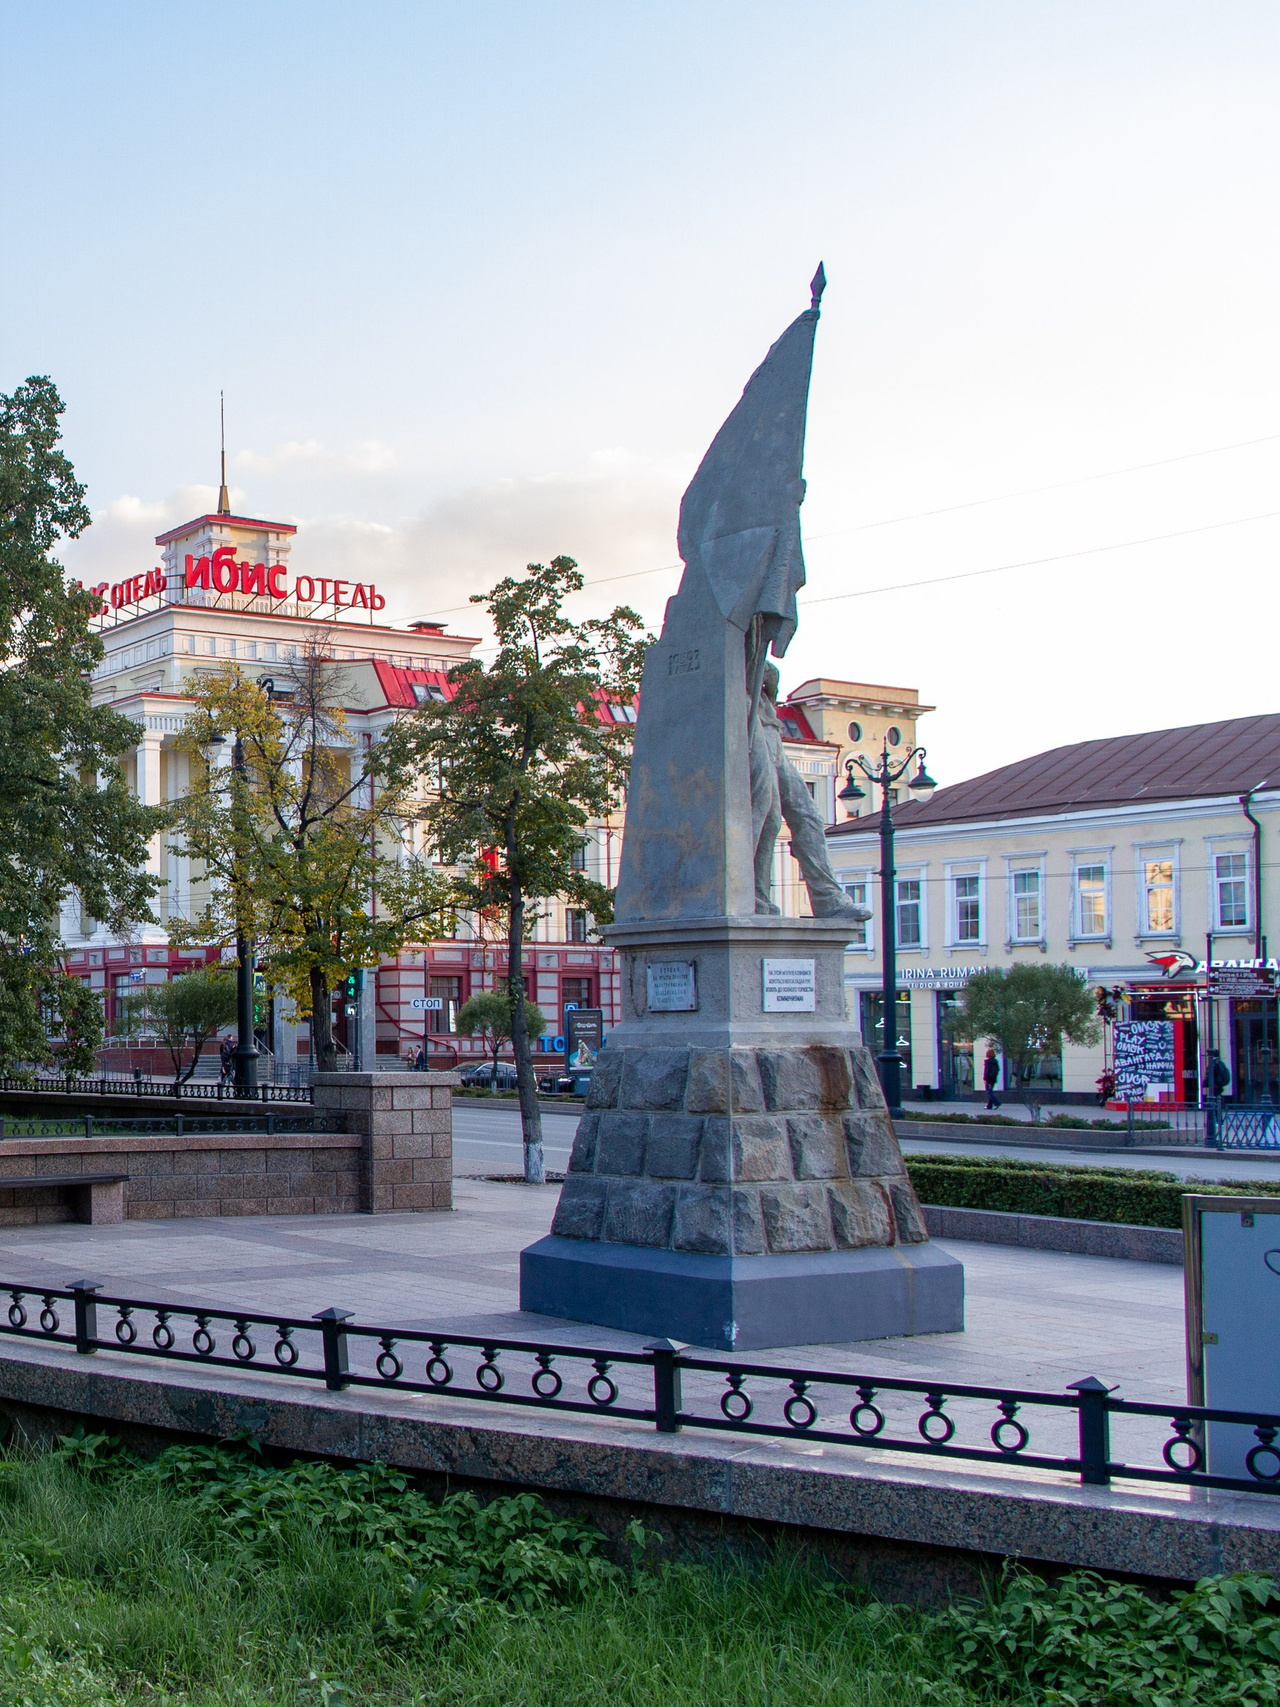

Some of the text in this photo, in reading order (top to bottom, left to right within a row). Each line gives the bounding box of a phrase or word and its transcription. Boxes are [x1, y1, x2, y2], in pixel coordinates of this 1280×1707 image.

[111, 566, 167, 610] ОТЕЛЬ
[295, 575, 386, 611] ОТЕЛЬ
[901, 968, 935, 979] IRINA
[412, 999, 441, 1009] СТОП
